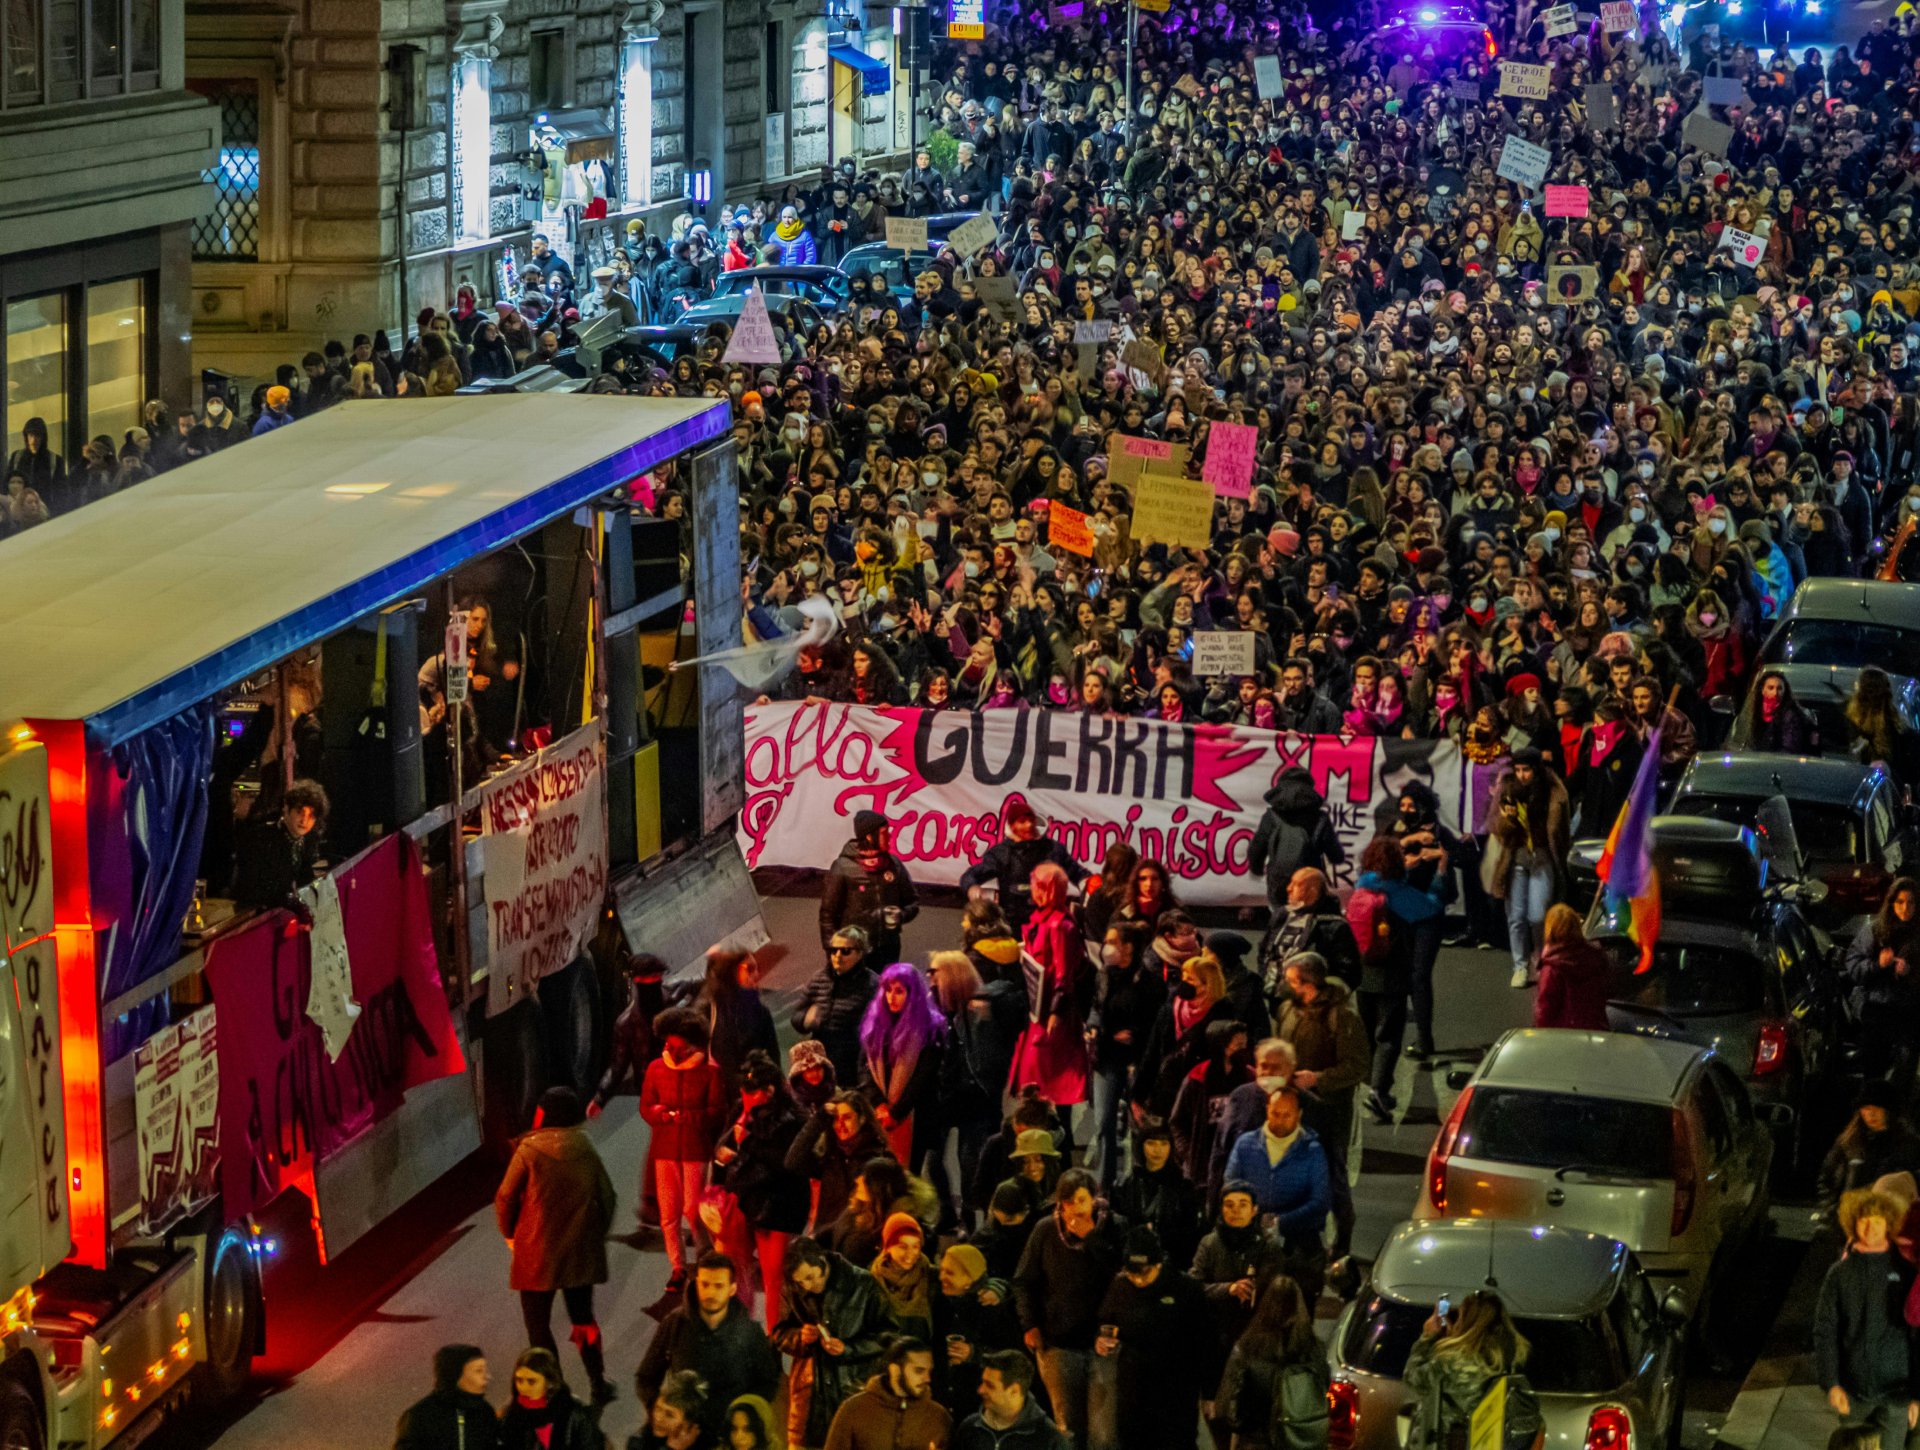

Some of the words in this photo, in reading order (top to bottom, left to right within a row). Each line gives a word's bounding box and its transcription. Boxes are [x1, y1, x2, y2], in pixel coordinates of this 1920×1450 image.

[1511, 75, 1523, 84] ER
[1517, 85, 1546, 97] CULO
[1200, 634, 1221, 643] GIRLS
[1227, 634, 1244, 643] JUST
[745, 702, 880, 787] alla
[913, 708, 1194, 800] GUERRA
